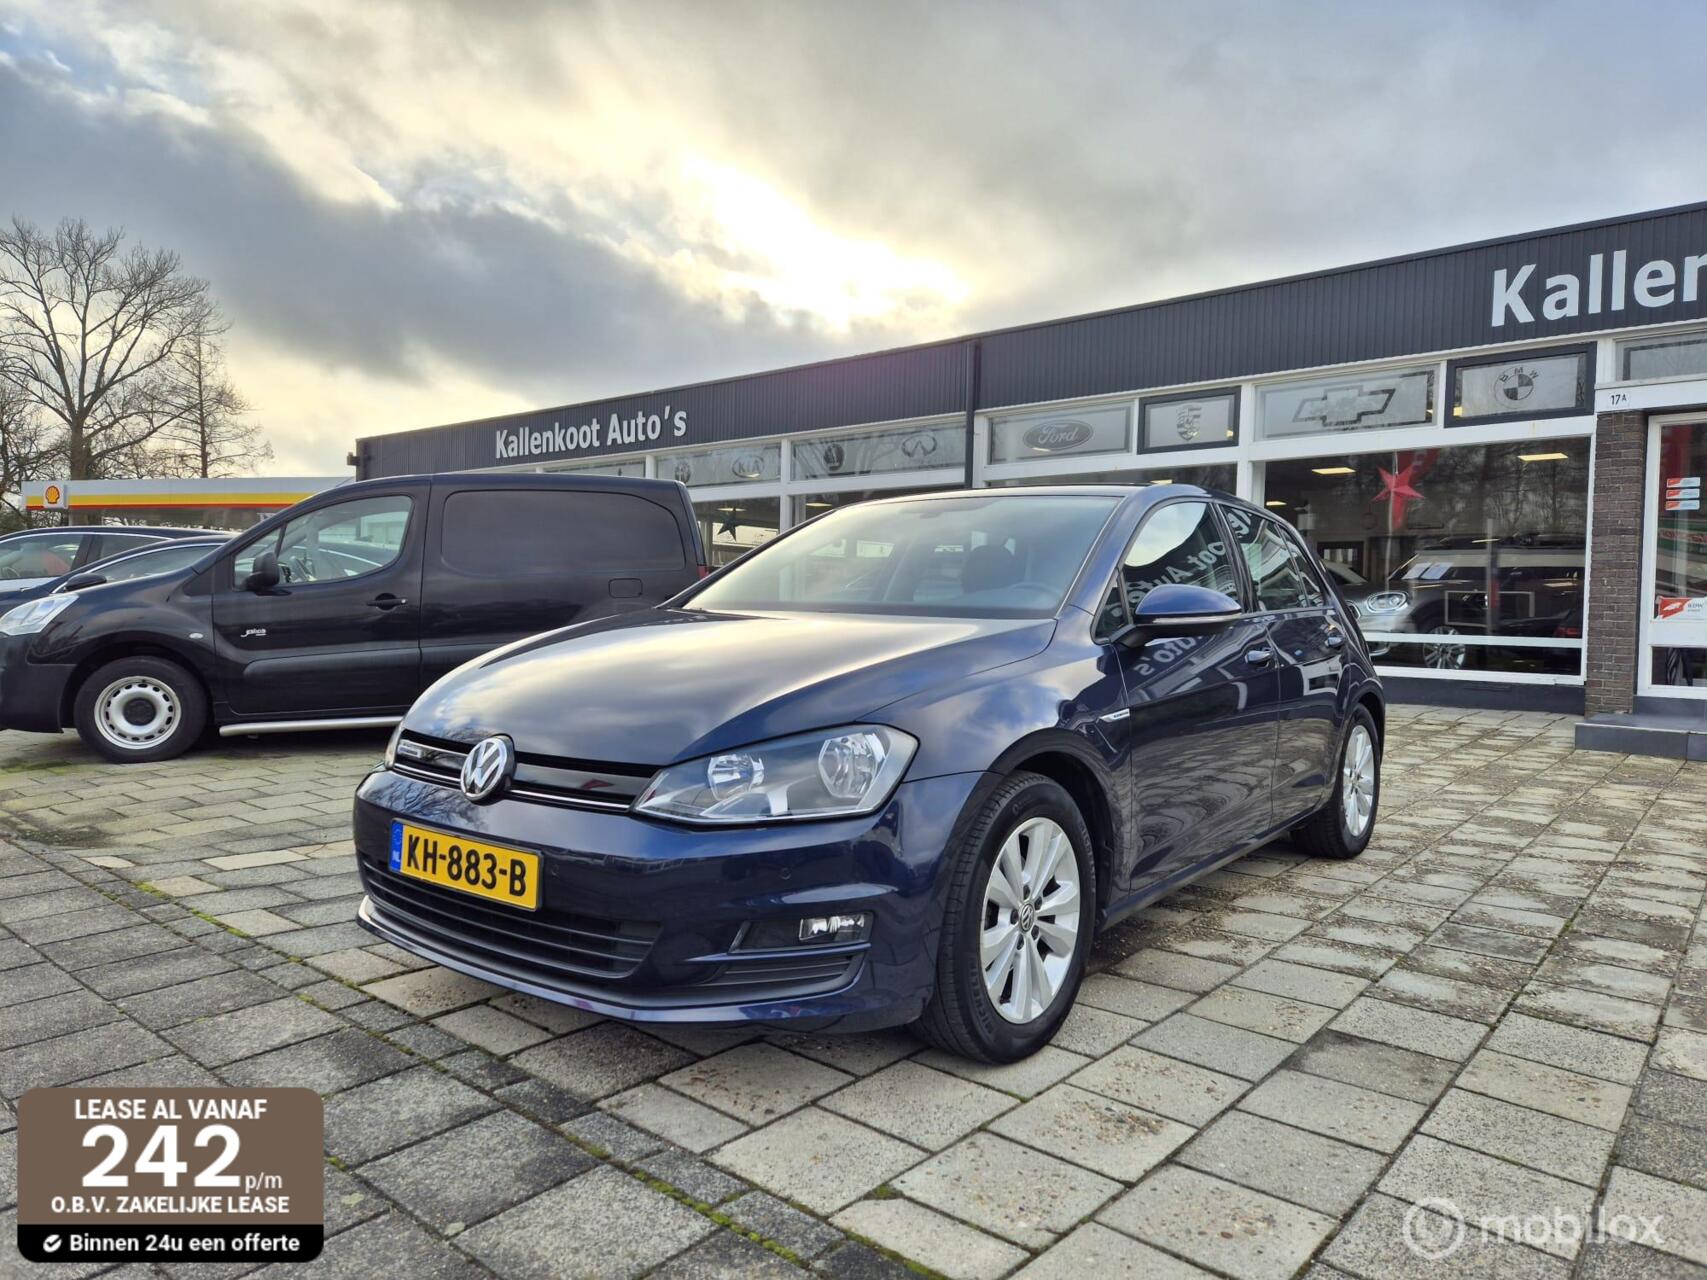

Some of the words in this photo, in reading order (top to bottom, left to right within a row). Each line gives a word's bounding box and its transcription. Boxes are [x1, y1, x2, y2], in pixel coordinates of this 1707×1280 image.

[496, 418, 600, 459] Kallenkoot
[606, 405, 687, 446] Auto's
[1038, 426, 1080, 444] Ford
[407, 834, 527, 897] KH-883-B
